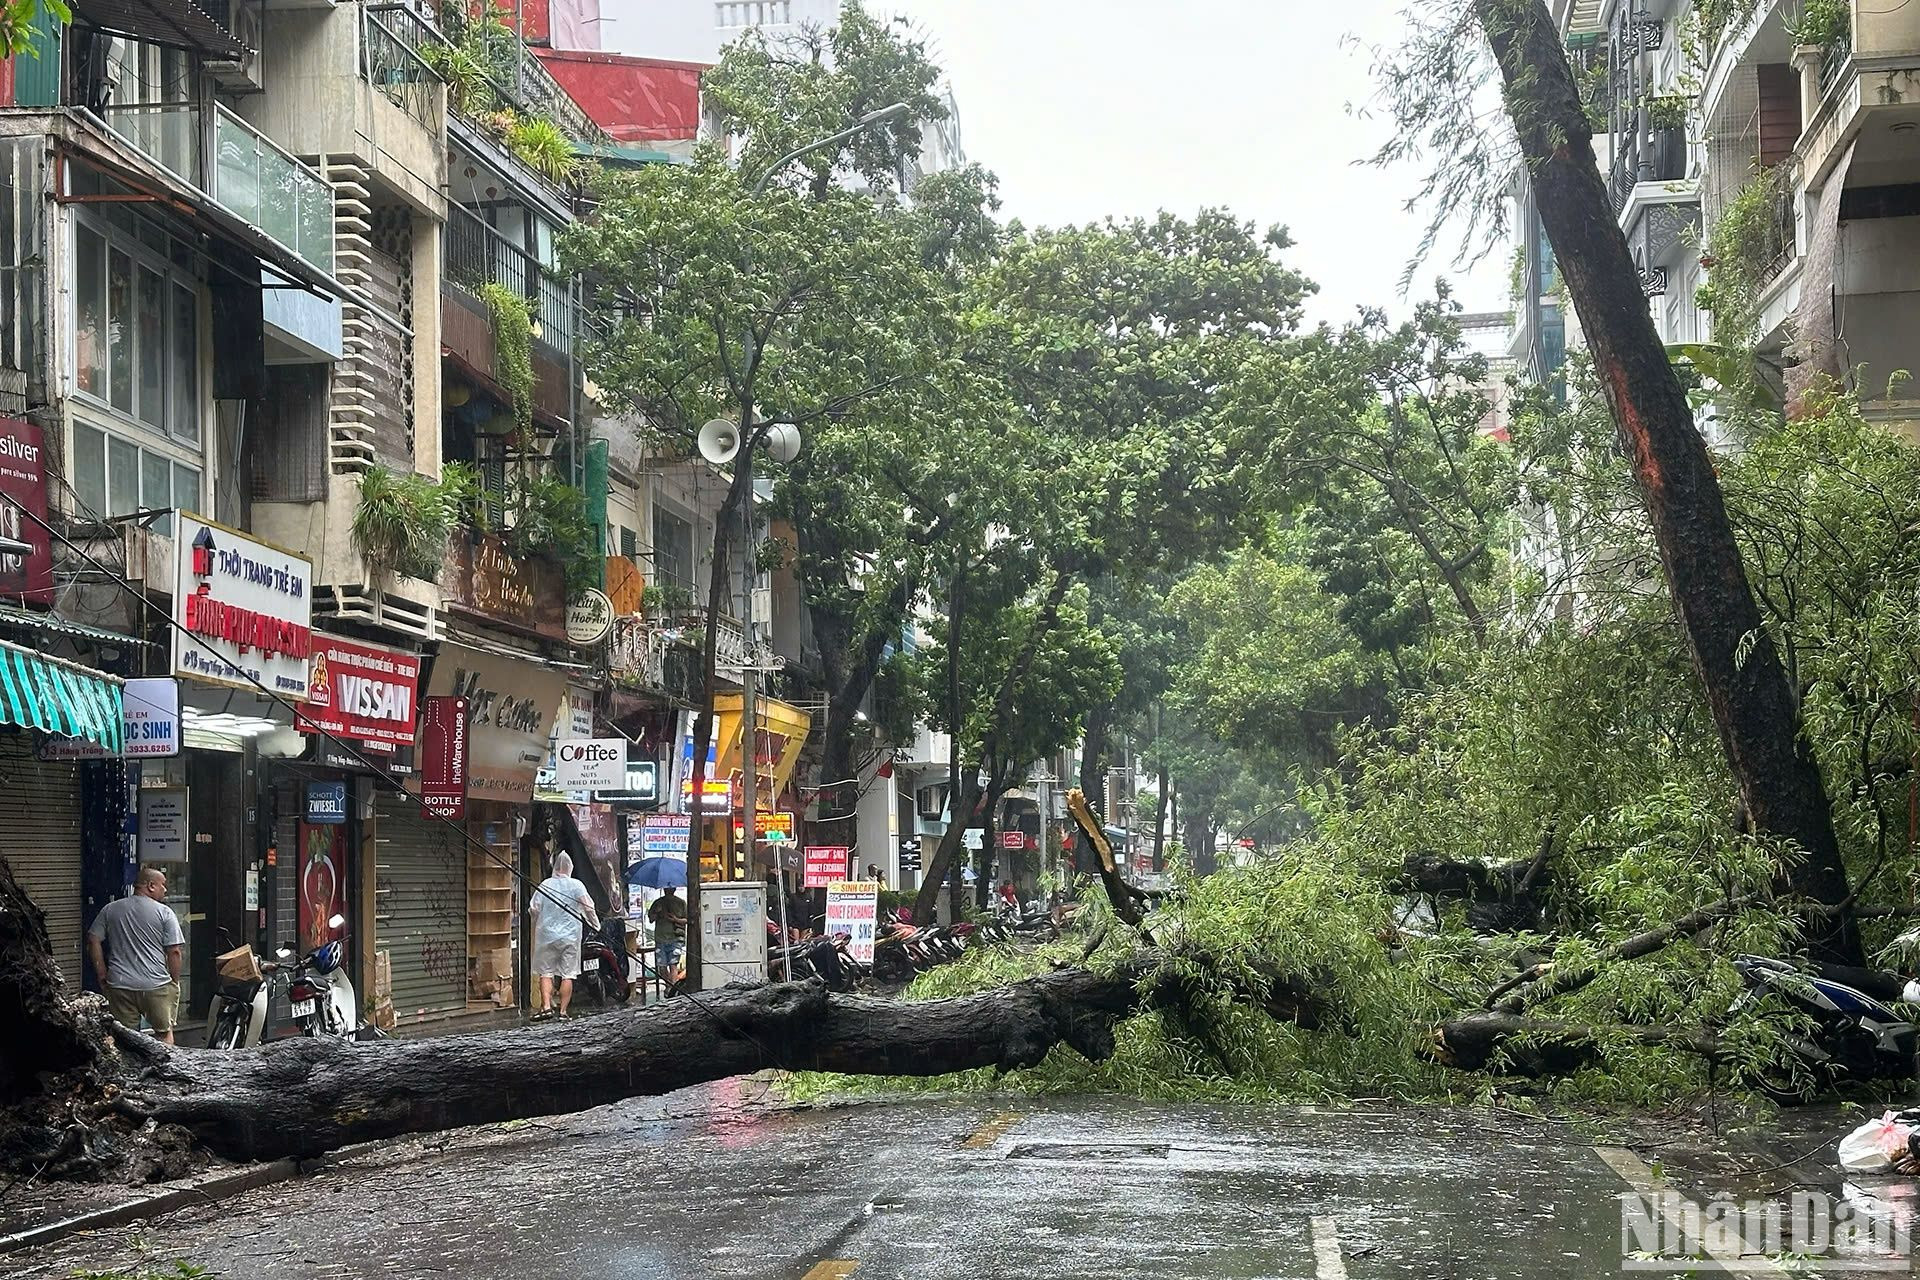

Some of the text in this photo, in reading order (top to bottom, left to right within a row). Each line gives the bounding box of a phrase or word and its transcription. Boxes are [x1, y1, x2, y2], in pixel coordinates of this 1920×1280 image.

[244, 559, 272, 588] TRANG
[291, 576, 303, 598] EM
[312, 691, 328, 702] VISSAN
[337, 673, 411, 722] VISSAN
[136, 711, 148, 719] EM
[142, 722, 172, 739] SINH
[452, 712, 464, 784] theWarehouse
[560, 744, 618, 762] Coffee
[309, 799, 336, 813] ZWIESEL
[424, 796, 461, 805] BOTTLE
[645, 817, 691, 827] BOOKING OFFICE
[841, 884, 876, 892] SINH CAFE
[827, 904, 874, 919] MONEY EXCHANGE
